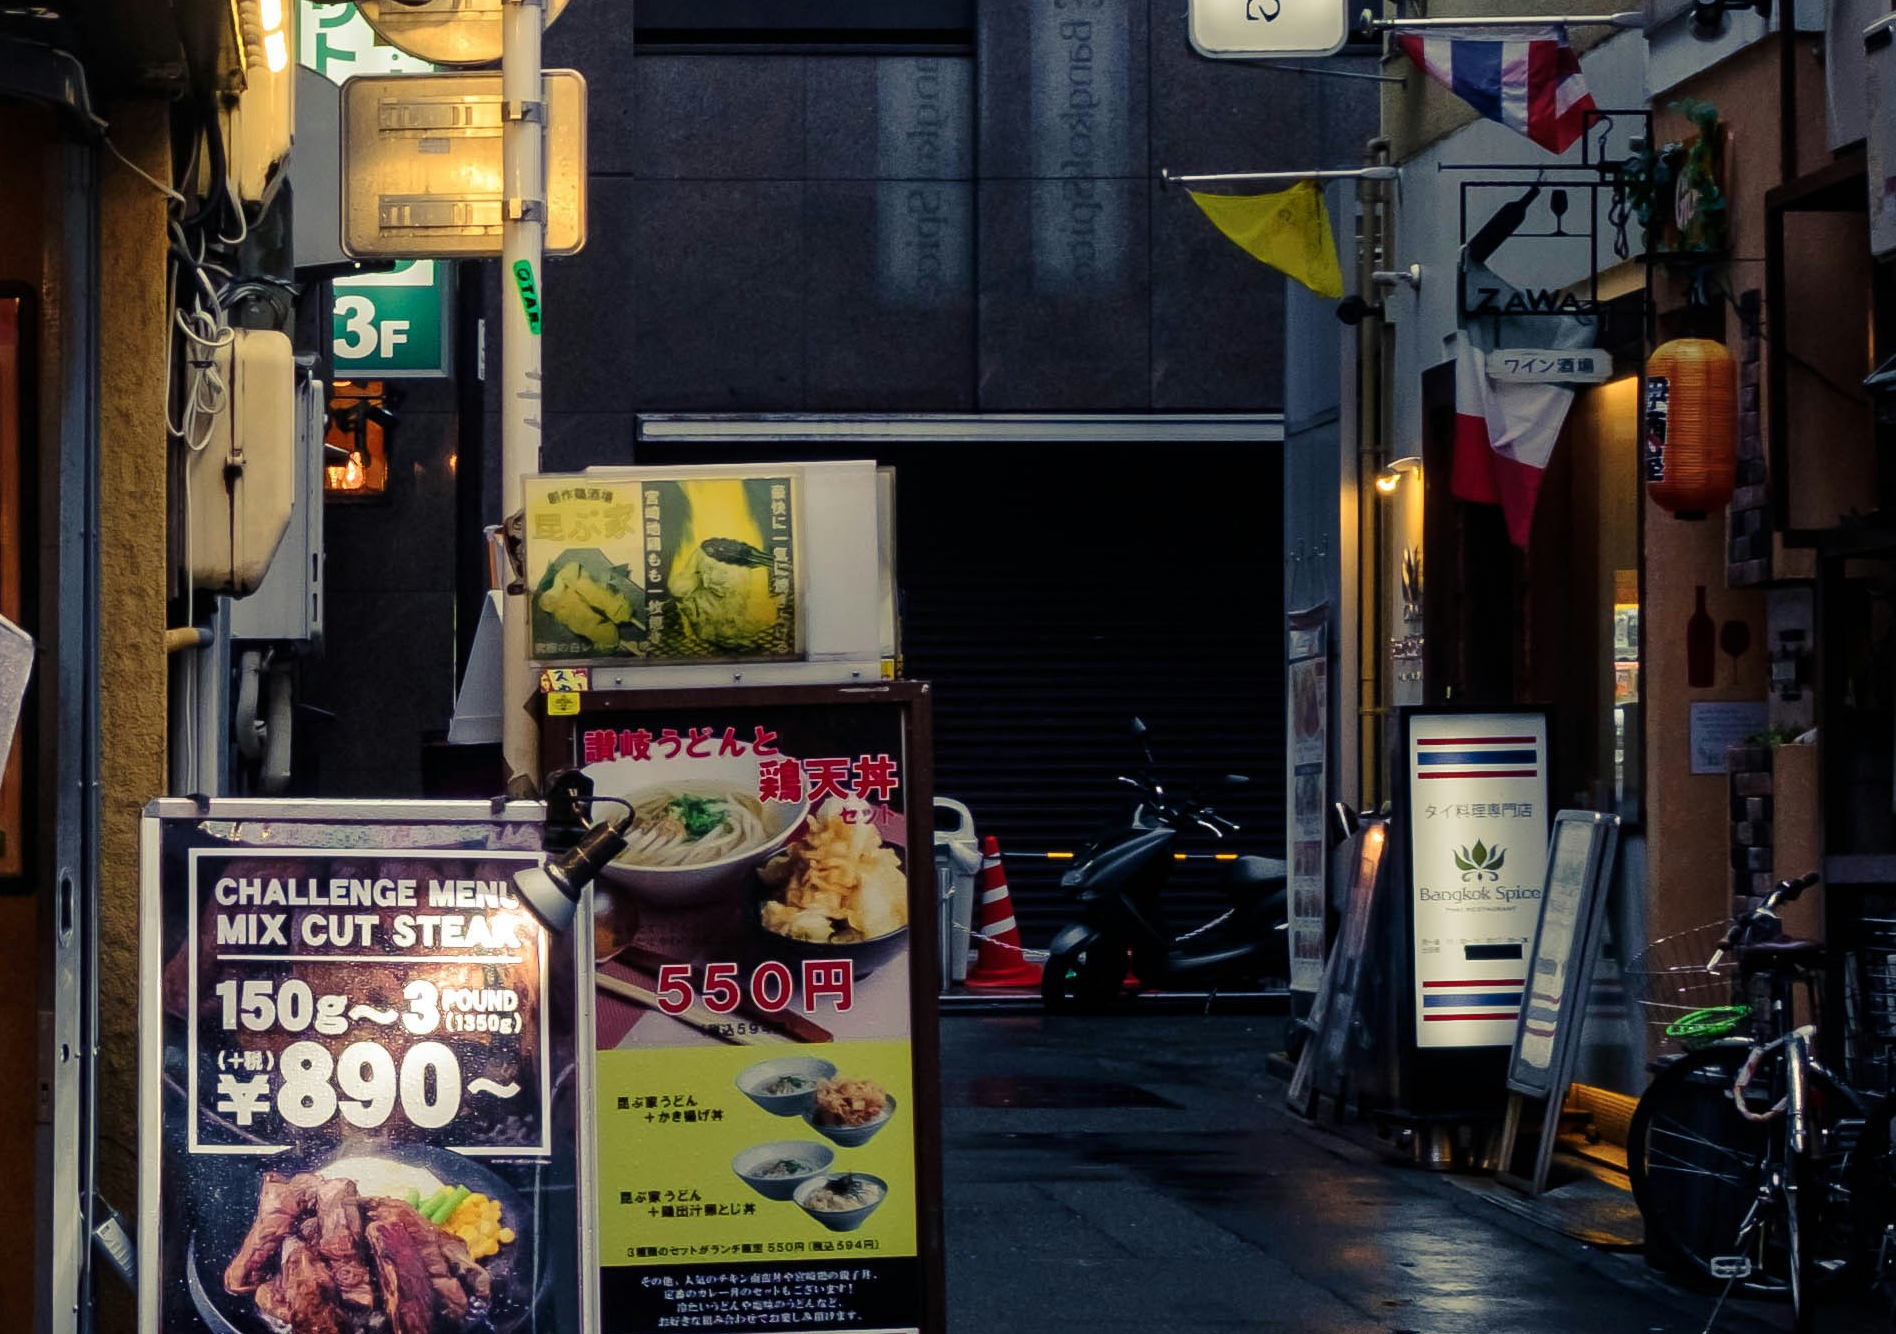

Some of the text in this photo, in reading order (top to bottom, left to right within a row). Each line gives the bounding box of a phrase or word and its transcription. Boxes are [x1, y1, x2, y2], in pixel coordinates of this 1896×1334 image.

[1476, 288, 1579, 312] ZAWA
[333, 295, 411, 359] 3F
[1503, 357, 1595, 375] ワイン酒場
[582, 726, 781, 764] 讃岐うどんと
[758, 754, 900, 805] 鶏天丼
[838, 802, 897, 828] セット
[1424, 801, 1533, 820] タイ料理専門店
[215, 878, 417, 908] CHALLENGE
[1419, 885, 1542, 906] Bangkok Spice
[216, 914, 522, 950] MIX CUT STEAK
[441, 987, 519, 1012] POUND
[655, 959, 855, 1017] 550円
